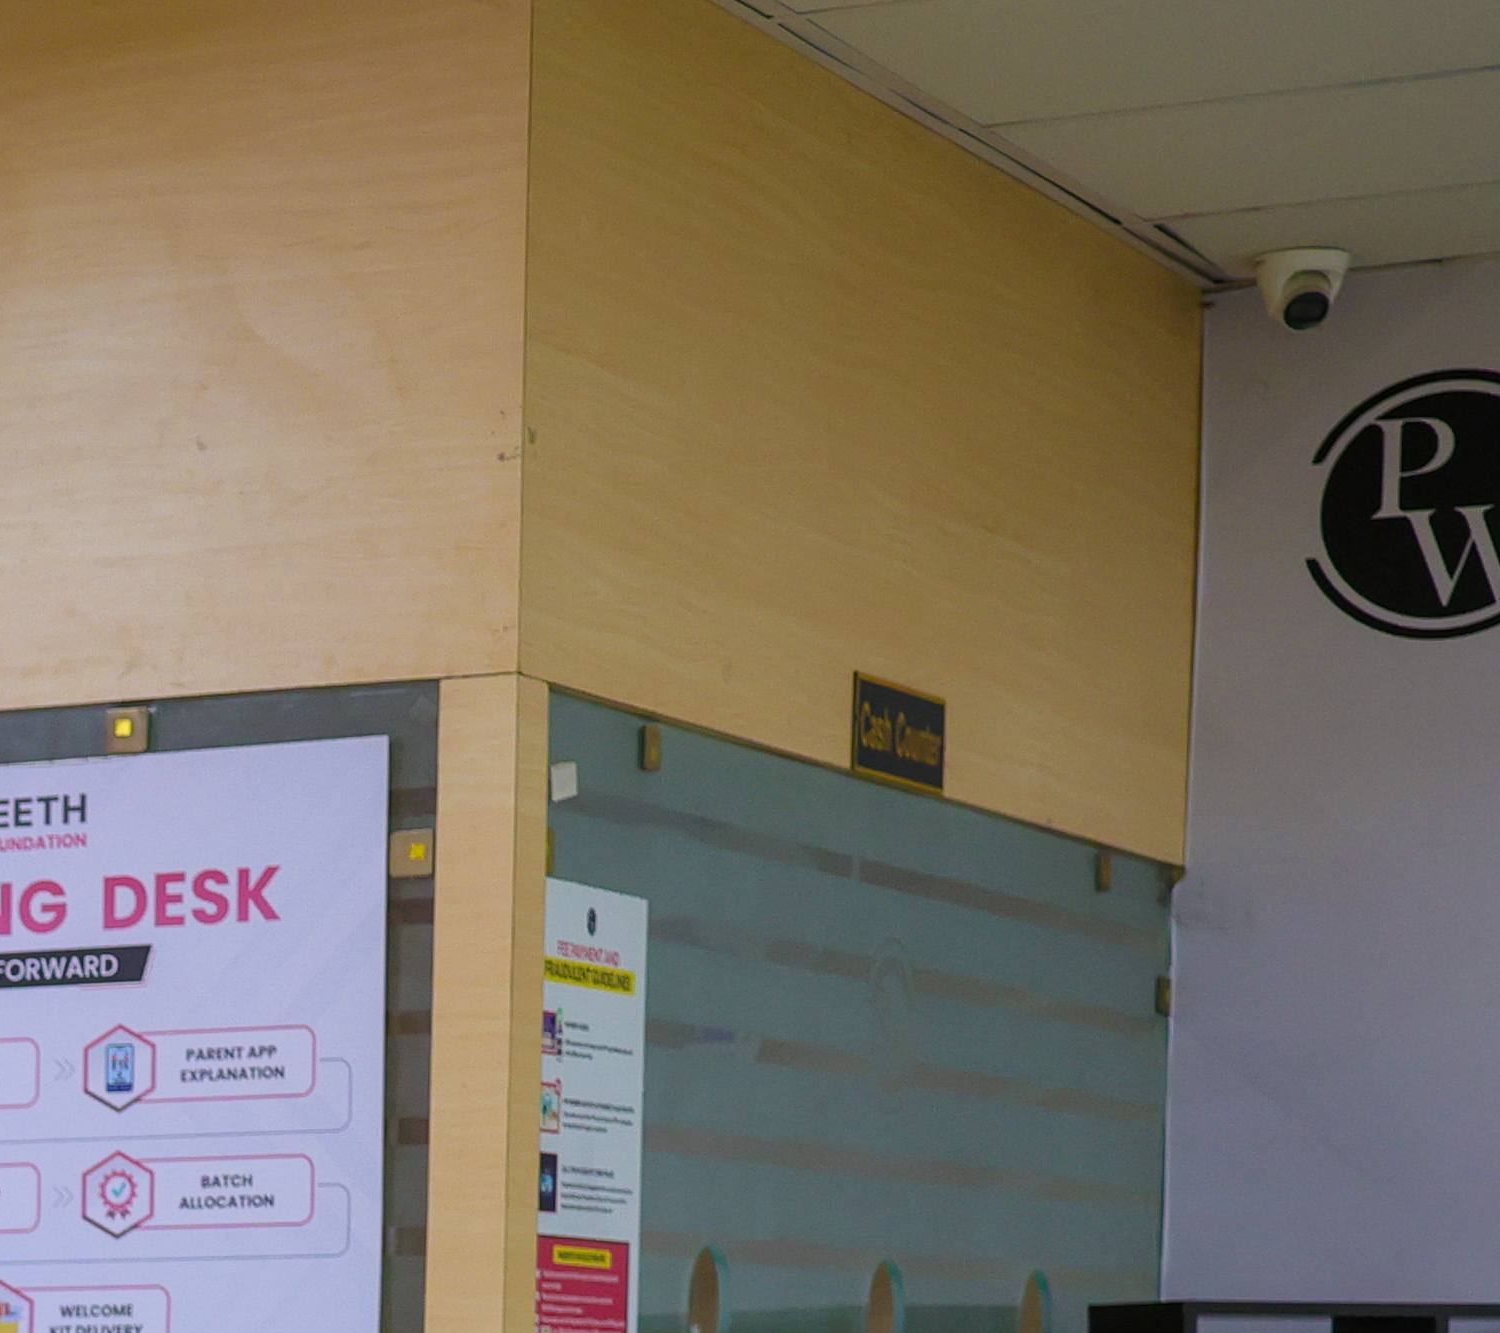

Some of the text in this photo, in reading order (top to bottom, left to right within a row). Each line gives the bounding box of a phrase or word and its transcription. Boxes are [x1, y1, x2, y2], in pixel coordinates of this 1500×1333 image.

[103, 865, 280, 929] DESK
[185, 1044, 277, 1062] PARENT APP
[180, 1063, 285, 1081] EXPLANATION
[201, 1174, 254, 1190] BATCH
[180, 1193, 276, 1210] ALLOCATION
